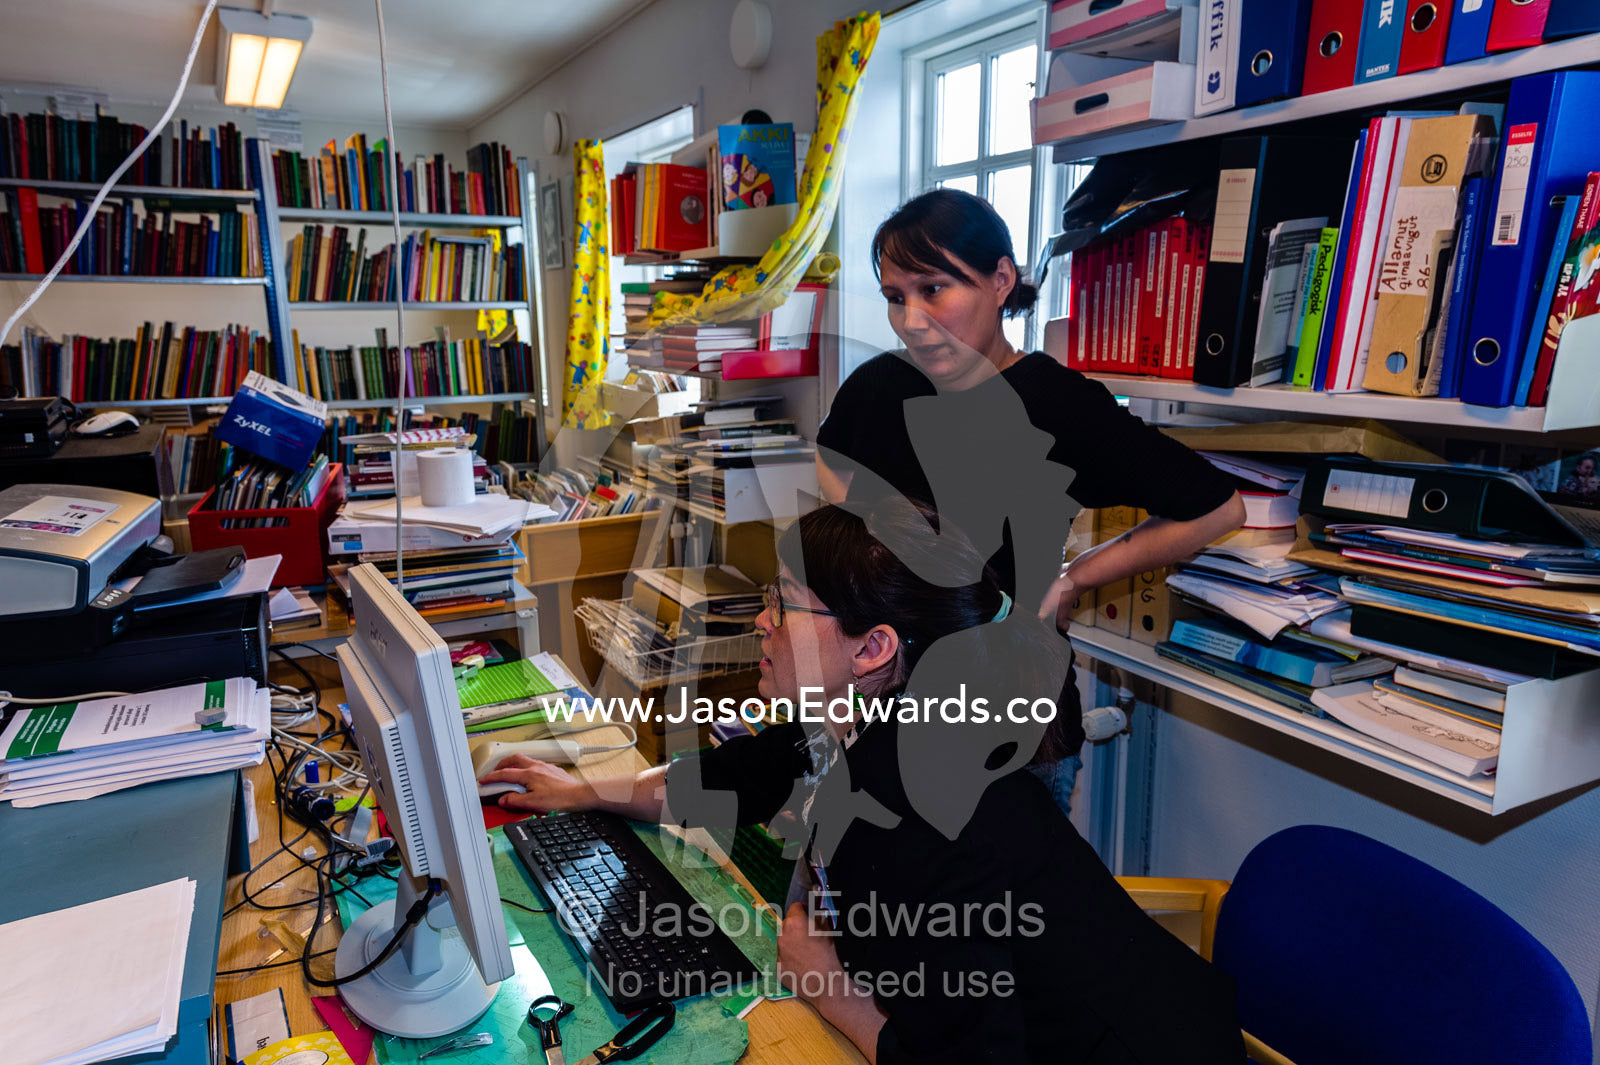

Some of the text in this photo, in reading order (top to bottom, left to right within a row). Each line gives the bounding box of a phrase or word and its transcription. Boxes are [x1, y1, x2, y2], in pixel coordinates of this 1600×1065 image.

[738, 127, 788, 143] AKKI
[1310, 246, 1332, 315] Pædagogisk
[1381, 218, 1409, 291] Allamut
[1399, 215, 1420, 290] qimaavugut
[234, 414, 271, 436] ZyXEL
